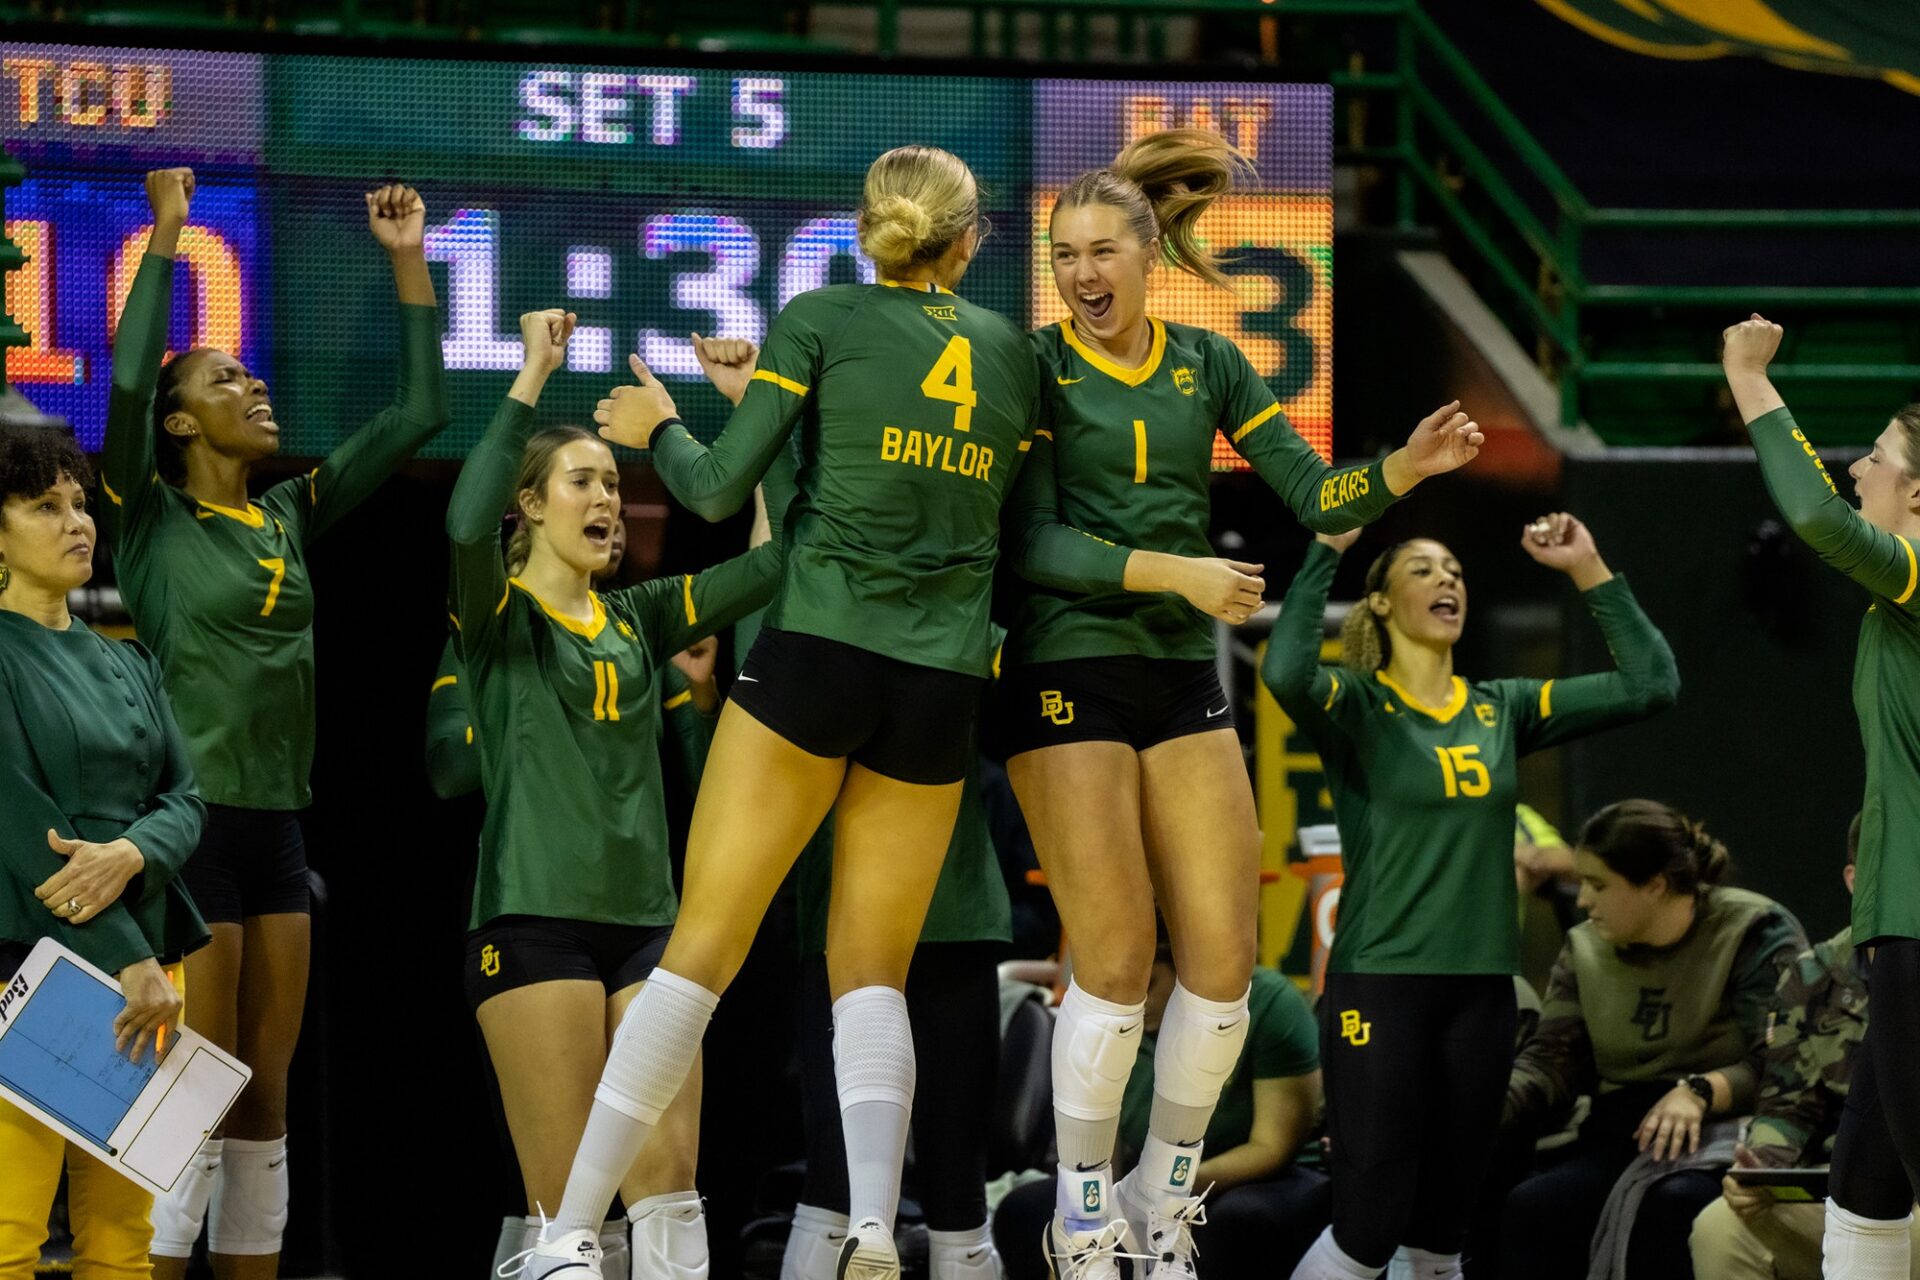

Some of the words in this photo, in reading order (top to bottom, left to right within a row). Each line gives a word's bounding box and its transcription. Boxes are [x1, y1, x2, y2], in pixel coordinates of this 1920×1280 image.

[3, 59, 172, 127] TCU
[518, 70, 698, 146] SET
[731, 77, 787, 149] 5
[4, 220, 241, 385] 10
[920, 335, 977, 433] 4
[881, 426, 994, 482] BAYLOR
[1133, 420, 1149, 484] 1
[1320, 467, 1370, 512] BEARS
[258, 558, 286, 616] 7
[593, 660, 620, 721] 11
[1435, 744, 1491, 798] 15
